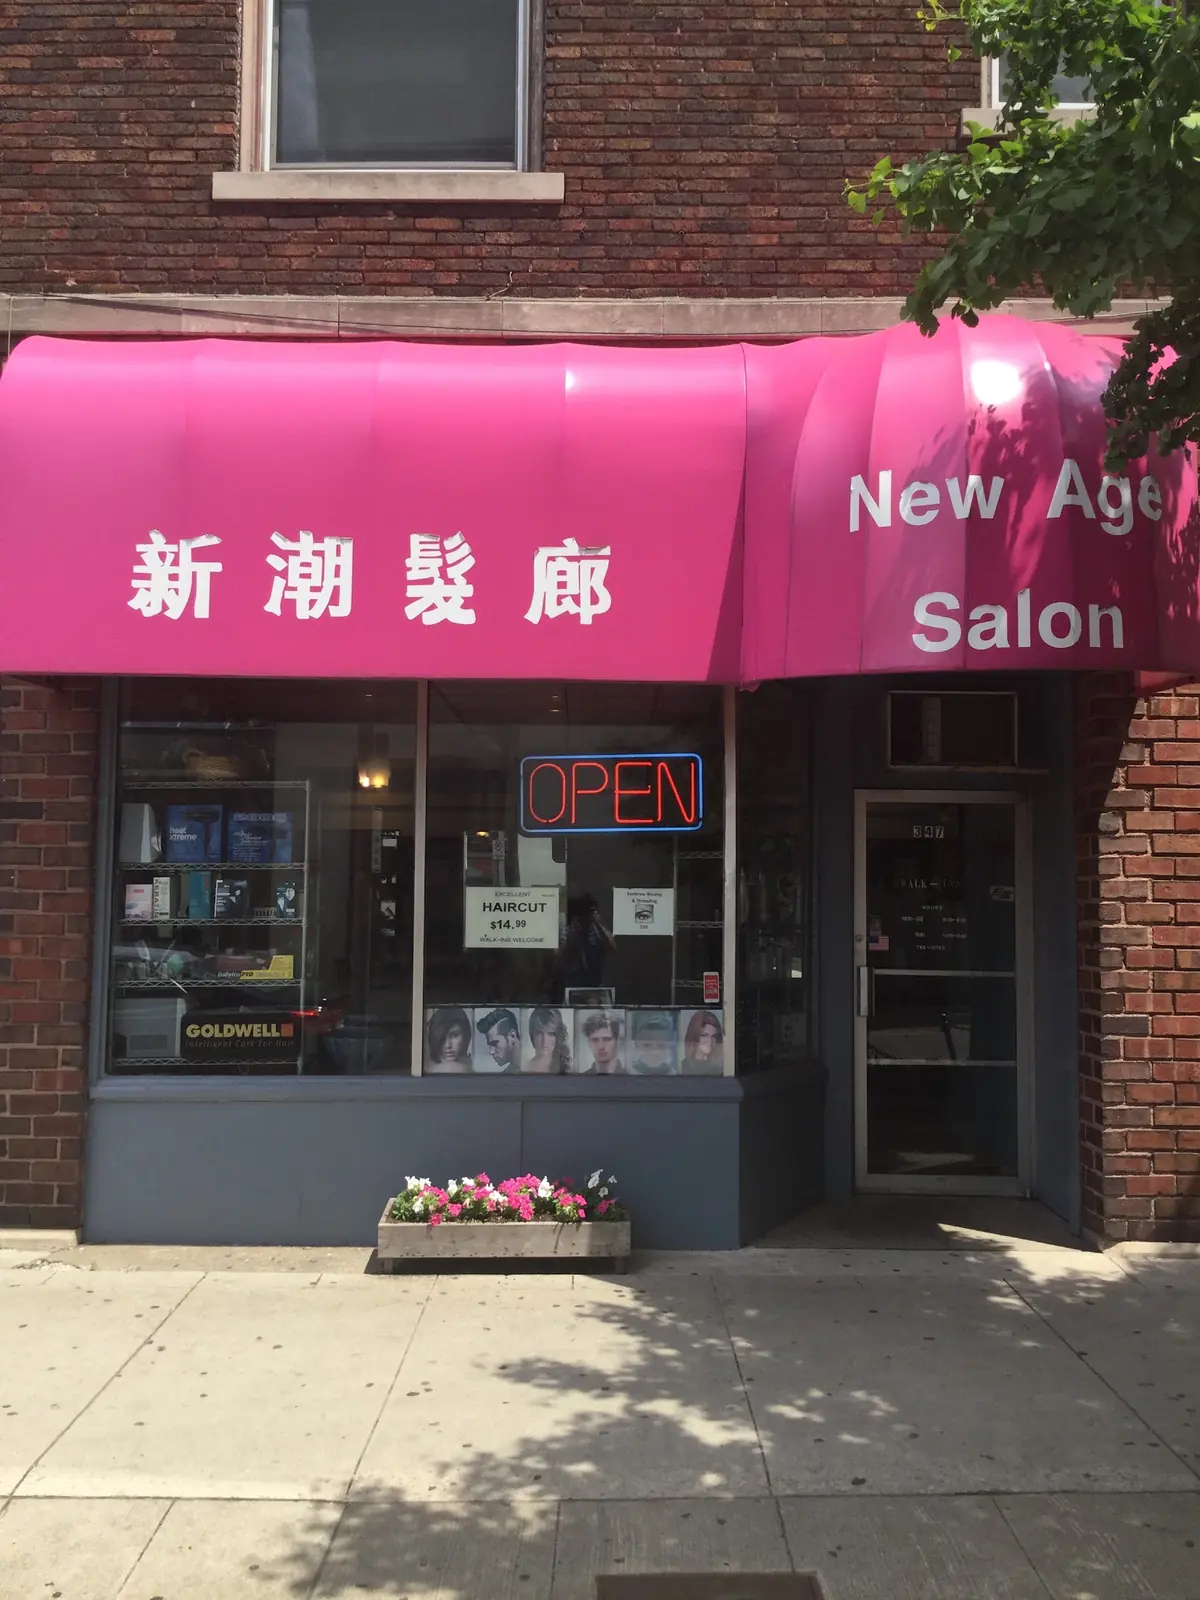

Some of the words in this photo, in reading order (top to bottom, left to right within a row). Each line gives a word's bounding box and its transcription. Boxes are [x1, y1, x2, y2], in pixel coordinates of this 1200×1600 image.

[850, 470, 1004, 533] New
[1046, 458, 1163, 536] Age
[912, 588, 1124, 653] Salon
[528, 762, 696, 825] OPEN
[913, 825, 945, 839] 347
[482, 902, 547, 912] HAIRCUT
[490, 919, 527, 930] $14.99
[186, 1023, 281, 1038] GOLDWELL
